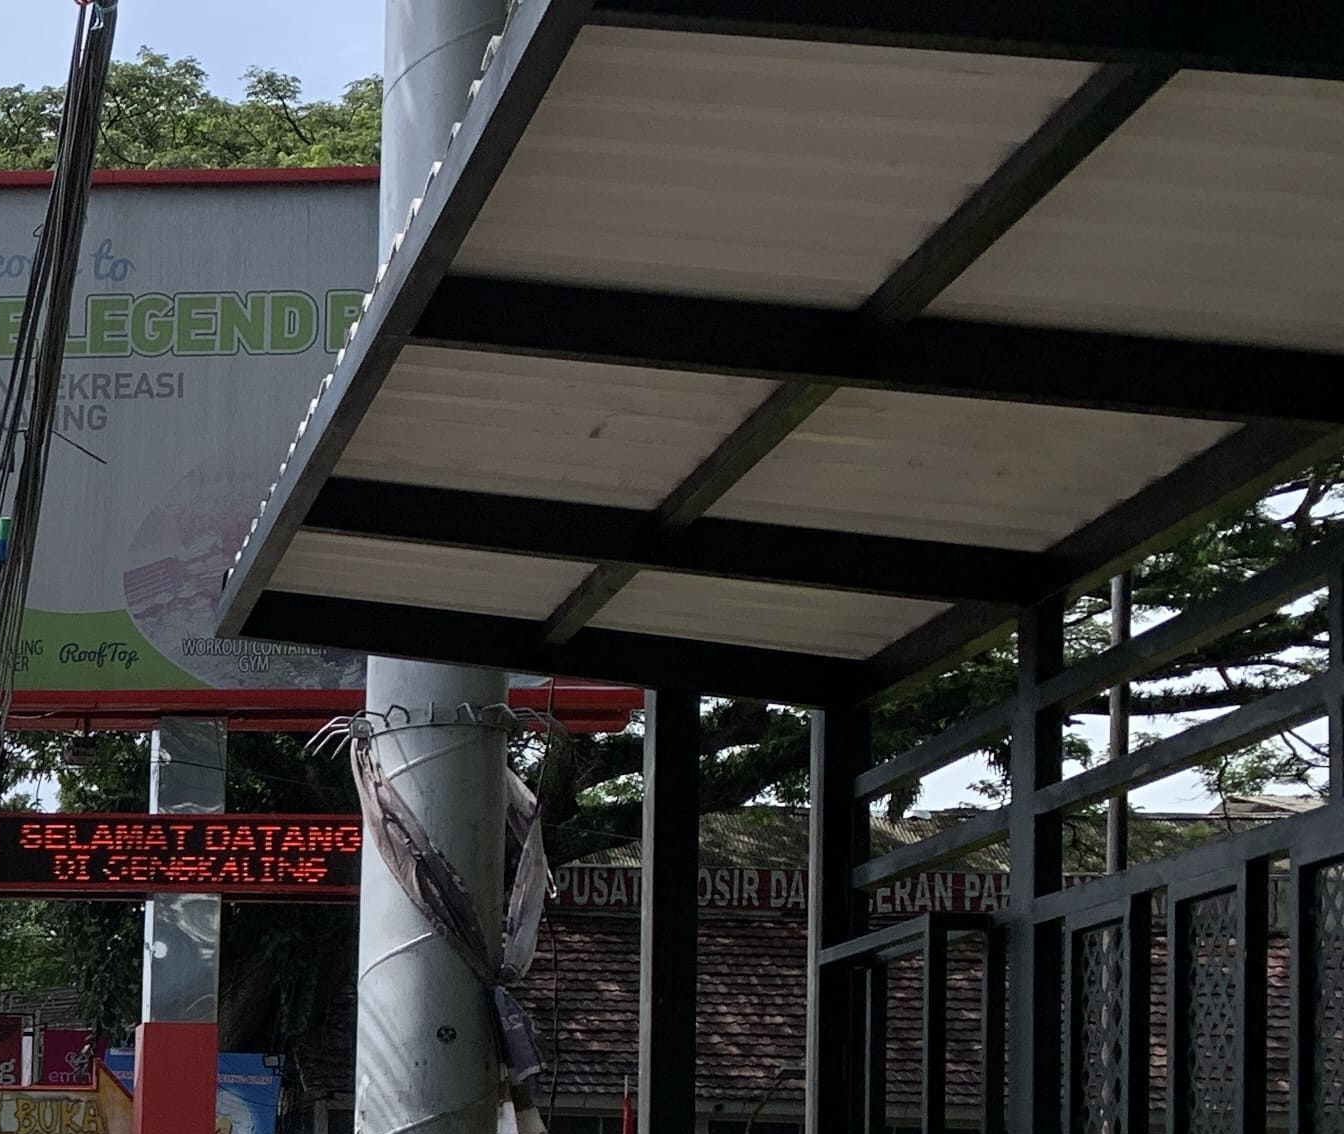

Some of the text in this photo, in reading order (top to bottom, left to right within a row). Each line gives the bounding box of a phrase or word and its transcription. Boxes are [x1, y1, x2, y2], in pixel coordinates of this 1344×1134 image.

[88, 238, 137, 282] to
[238, 656, 270, 673] GYM
[19, 824, 362, 852] SELAMAT DATANG
